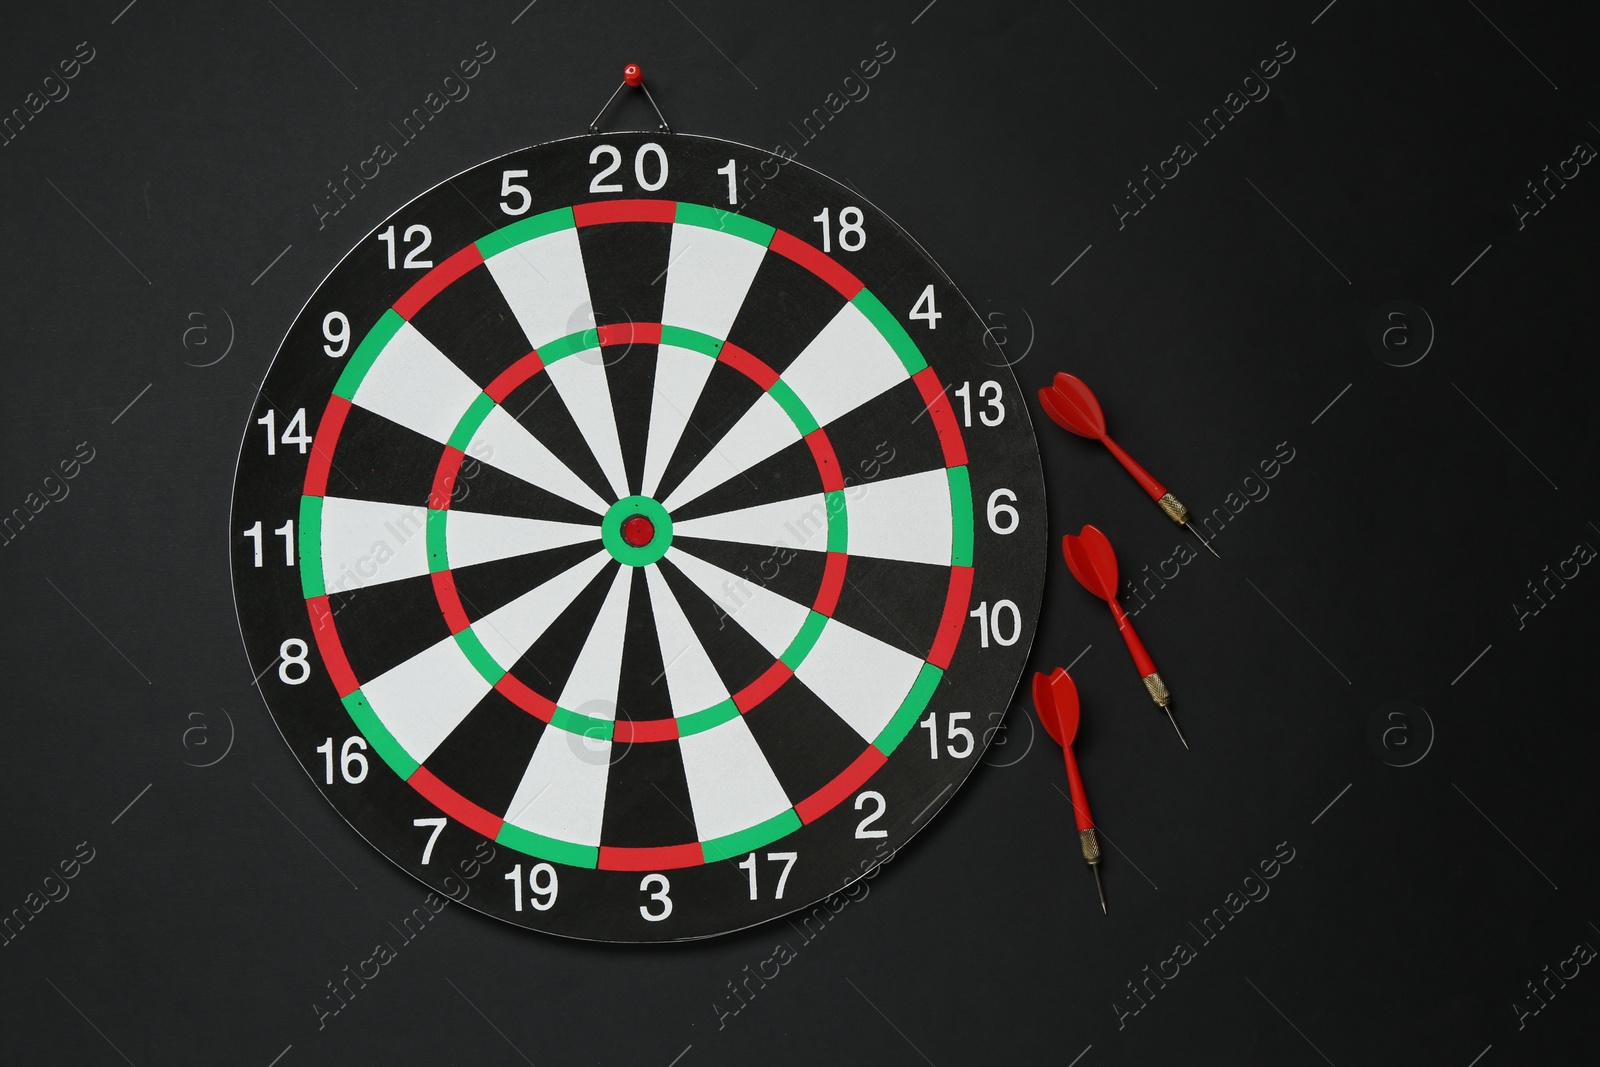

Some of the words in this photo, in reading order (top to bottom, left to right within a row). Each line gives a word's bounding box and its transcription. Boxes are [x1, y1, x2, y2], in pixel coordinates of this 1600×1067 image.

[588, 142, 668, 193] 20
[717, 158, 738, 205] 1
[499, 169, 532, 216] 5
[377, 224, 434, 270] 12
[813, 206, 867, 253] 18
[908, 284, 943, 330] 4
[322, 310, 351, 358] 9
[954, 380, 1006, 428] 13
[257, 407, 313, 456] 14
[986, 487, 1020, 535] 6
[243, 519, 295, 568] 11
[969, 599, 1022, 648] 10
[278, 637, 311, 686] 8
[316, 735, 369, 785] 16
[920, 711, 975, 760] 15
[854, 790, 889, 840] 2
[413, 817, 448, 865] 7
[504, 862, 559, 912] 19
[639, 873, 673, 922] 3
[738, 851, 798, 901] 17
